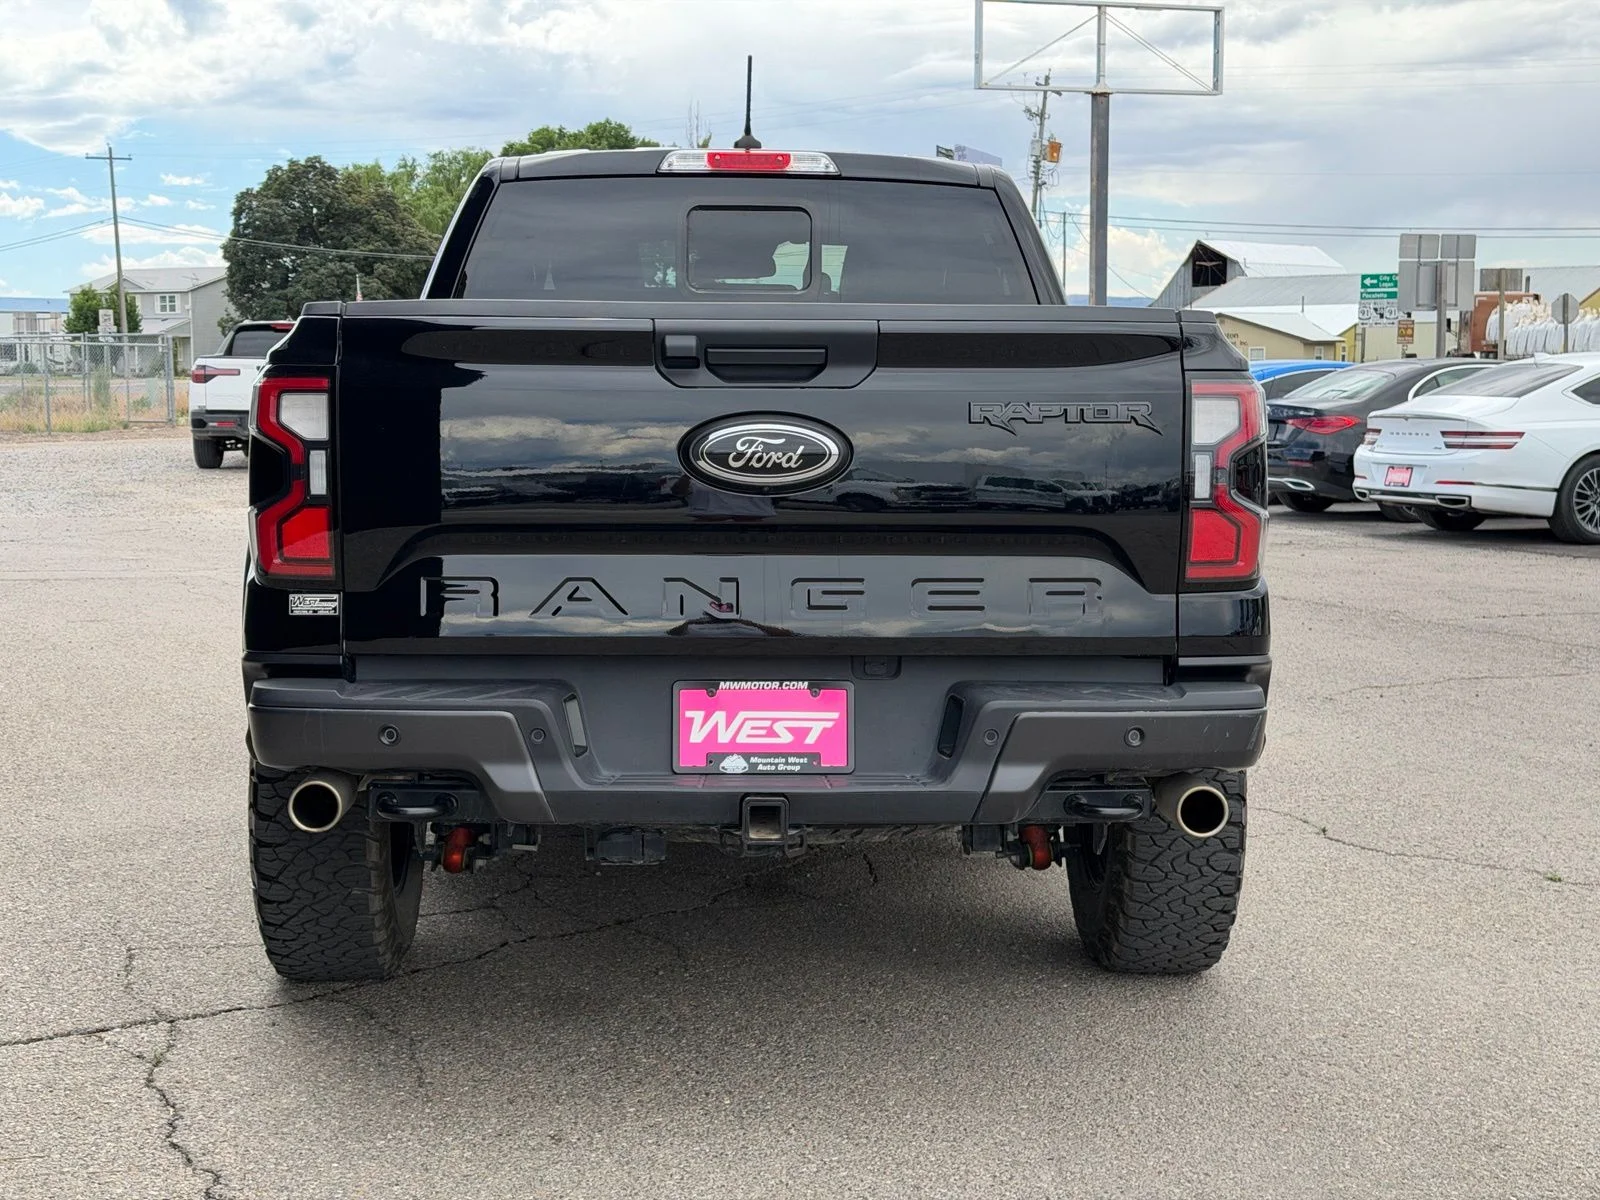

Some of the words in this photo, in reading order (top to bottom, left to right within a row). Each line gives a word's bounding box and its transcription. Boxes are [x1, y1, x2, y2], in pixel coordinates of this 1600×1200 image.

[1360, 309, 1369, 317] 91
[1388, 309, 1397, 317] 91
[968, 401, 1164, 436] RAPTOR
[728, 436, 803, 470] Ford
[420, 577, 1103, 620] RANGER
[719, 681, 809, 691] MWMOTOR.COM
[777, 764, 801, 772] Group
